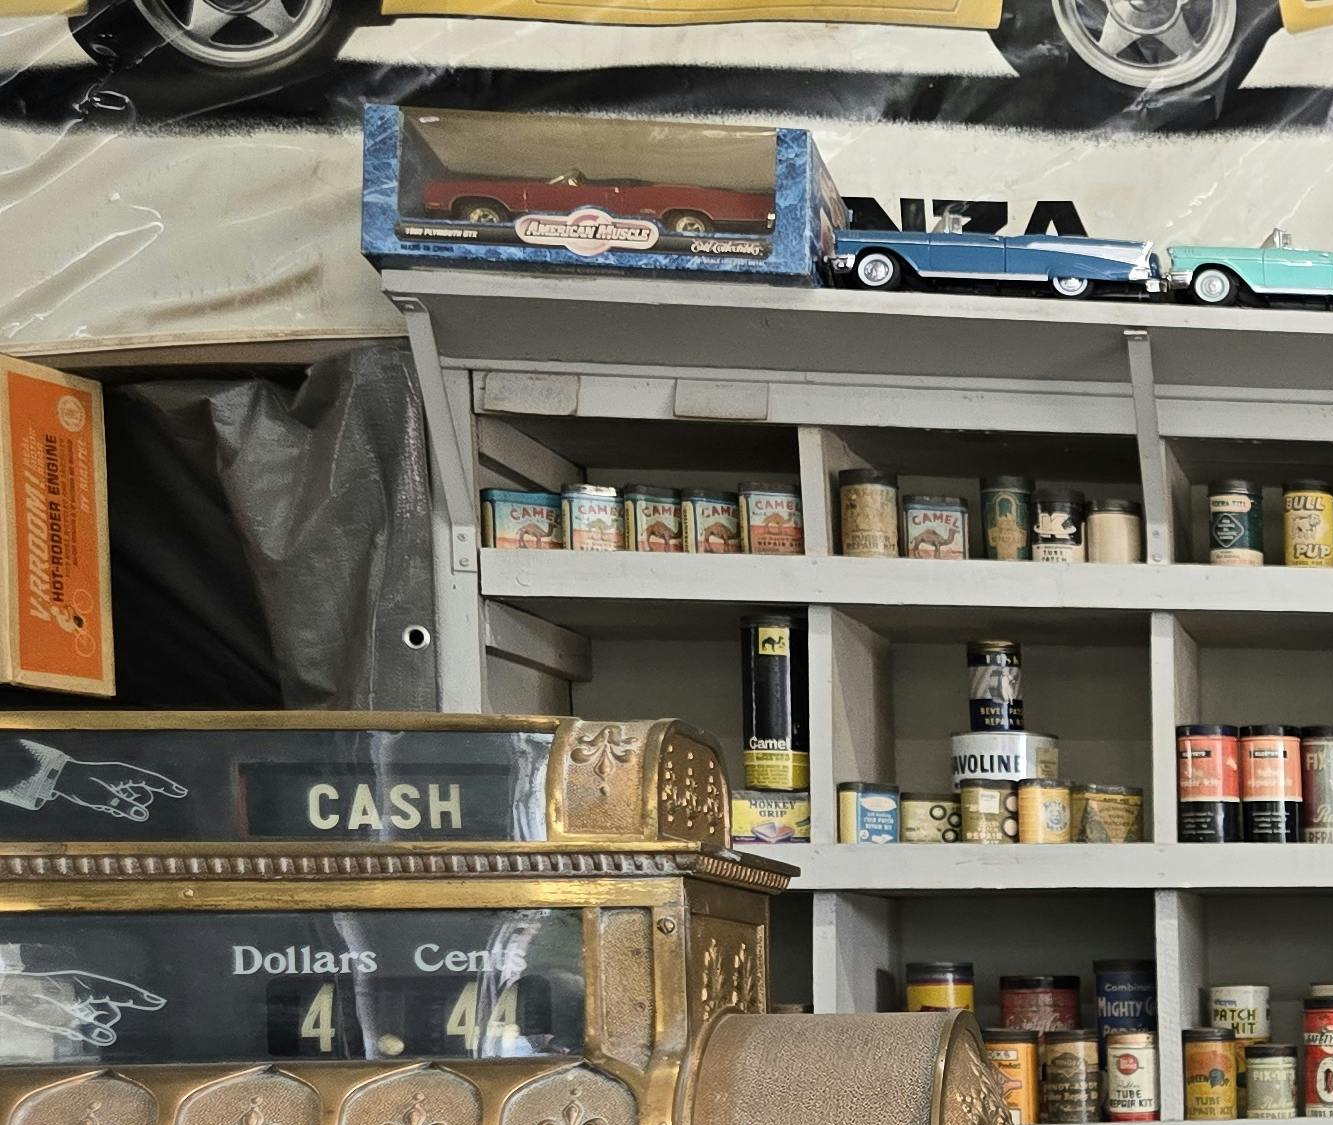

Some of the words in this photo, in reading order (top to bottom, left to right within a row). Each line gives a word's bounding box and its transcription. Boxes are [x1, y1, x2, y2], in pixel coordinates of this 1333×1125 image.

[525, 221, 594, 239] AMERICAN
[597, 225, 652, 242] MUSCLE
[45, 433, 60, 495] ENGINE
[1285, 496, 1324, 511] BULL
[510, 506, 561, 522] CAMEL
[912, 513, 960, 528] CAMEL
[49, 502, 64, 602] HOT-RODDER
[1294, 544, 1330, 559] PUP
[749, 736, 790, 751] Camel
[952, 755, 1022, 775] AVOLINE
[308, 783, 463, 831] CASH
[749, 800, 795, 810] MONKEY
[759, 809, 788, 818] GRIP
[232, 945, 378, 977] Dollars
[413, 944, 529, 973] Cents
[1099, 997, 1143, 1018] MIGHTY
[1214, 1009, 1256, 1020] PATCH
[300, 982, 336, 1053] 4
[446, 982, 518, 1052] 44
[1231, 1022, 1255, 1034] KIT
[1116, 1090, 1142, 1099] TUBE
[1139, 1099, 1153, 1108] KIT
